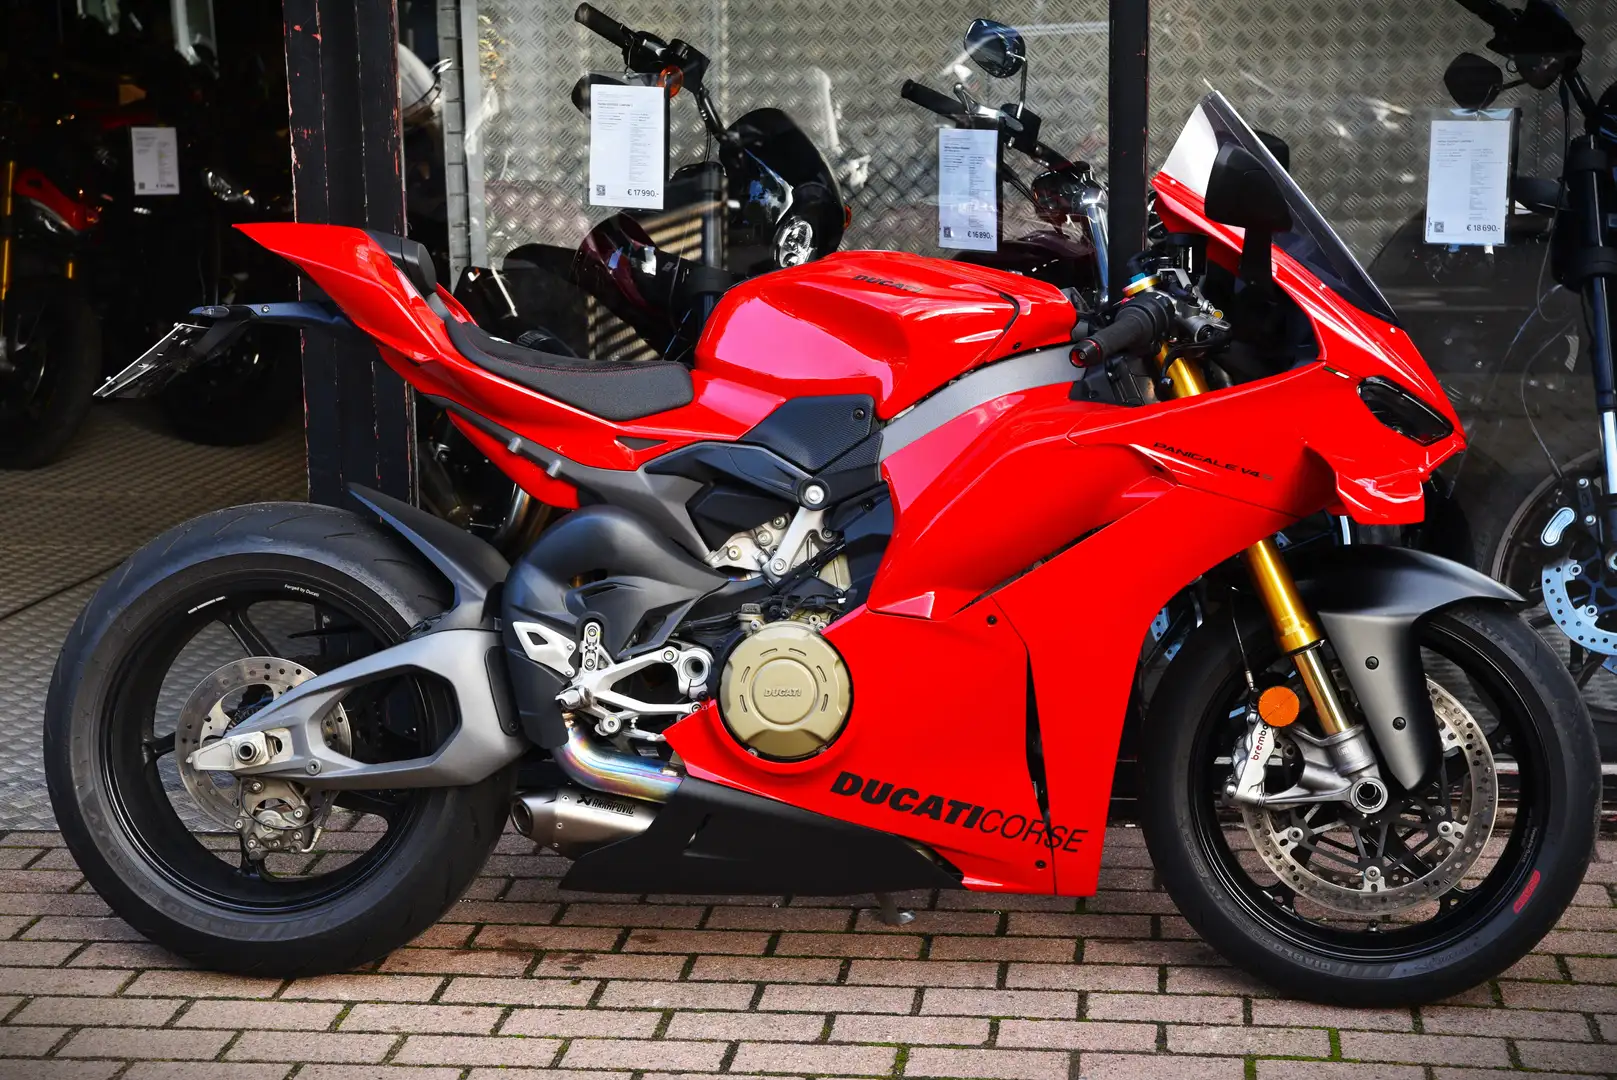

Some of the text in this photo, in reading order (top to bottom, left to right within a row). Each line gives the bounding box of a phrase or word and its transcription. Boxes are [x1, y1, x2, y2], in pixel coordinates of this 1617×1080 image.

[627, 188, 632, 196] €
[1466, 224, 1472, 232] €
[852, 274, 923, 293] DUCATI
[284, 583, 300, 592] Forged
[764, 688, 802, 698] DUCATI
[1251, 723, 1269, 761] brembo
[1273, 944, 1331, 970] DIABLO
